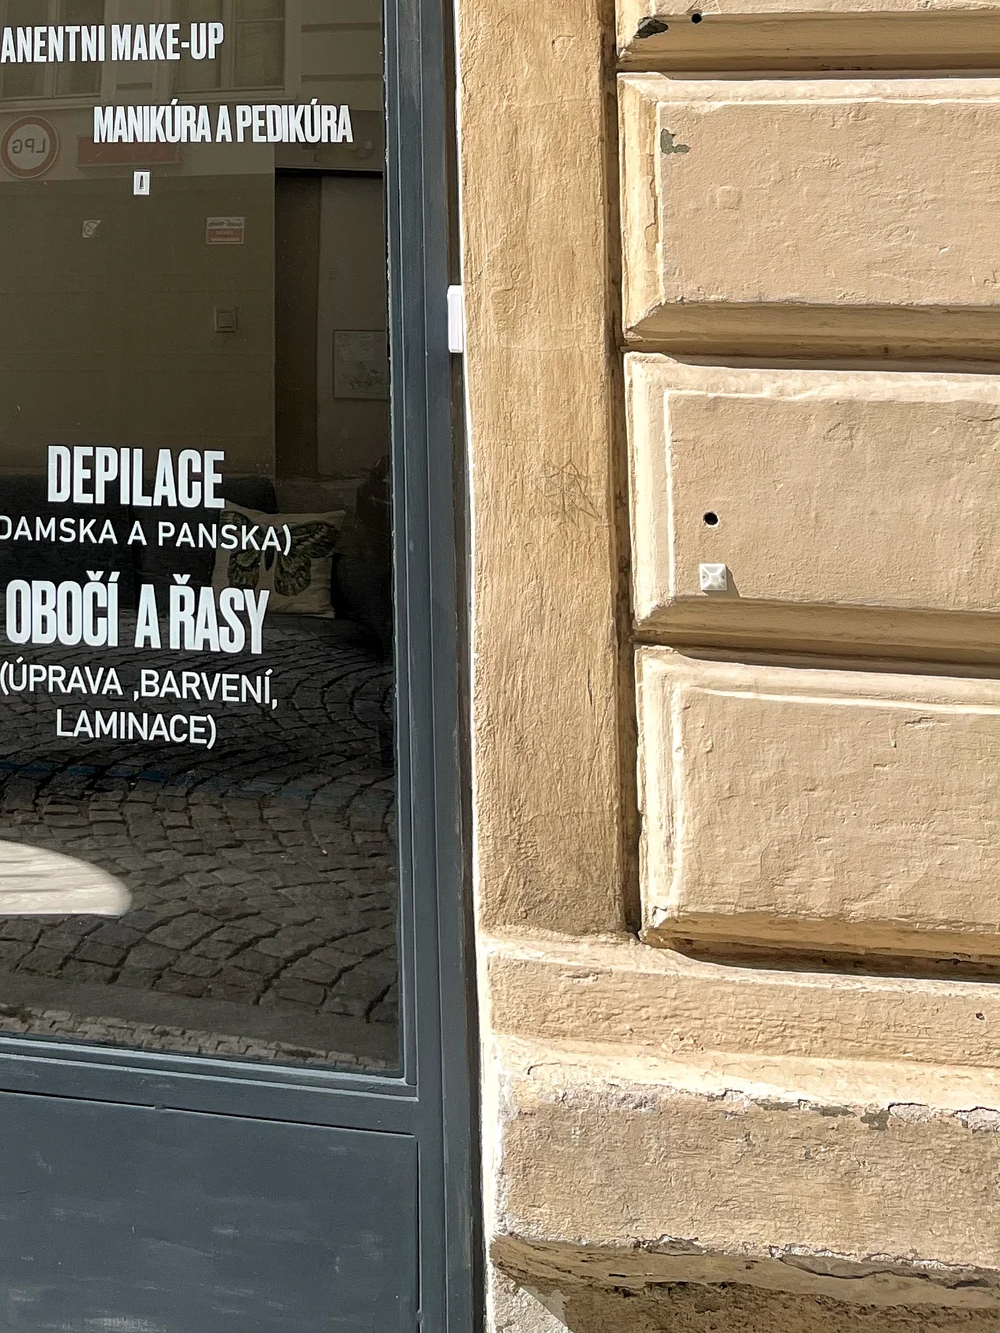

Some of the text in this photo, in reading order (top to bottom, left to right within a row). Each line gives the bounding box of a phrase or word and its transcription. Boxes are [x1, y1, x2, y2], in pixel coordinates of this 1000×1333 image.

[111, 22, 225, 61] MAKE-UP
[94, 98, 354, 143] MANIKÚRA A PEDIKÚRA
[47, 444, 226, 509] DEPILACE
[127, 520, 147, 546] A
[157, 521, 293, 556] PANSKA)
[5, 570, 270, 655] OBOČÍ A ŘASY
[0, 656, 279, 710] (ÚPRAVA ,BARVENÍ,
[56, 708, 217, 750] LAMINACE)
